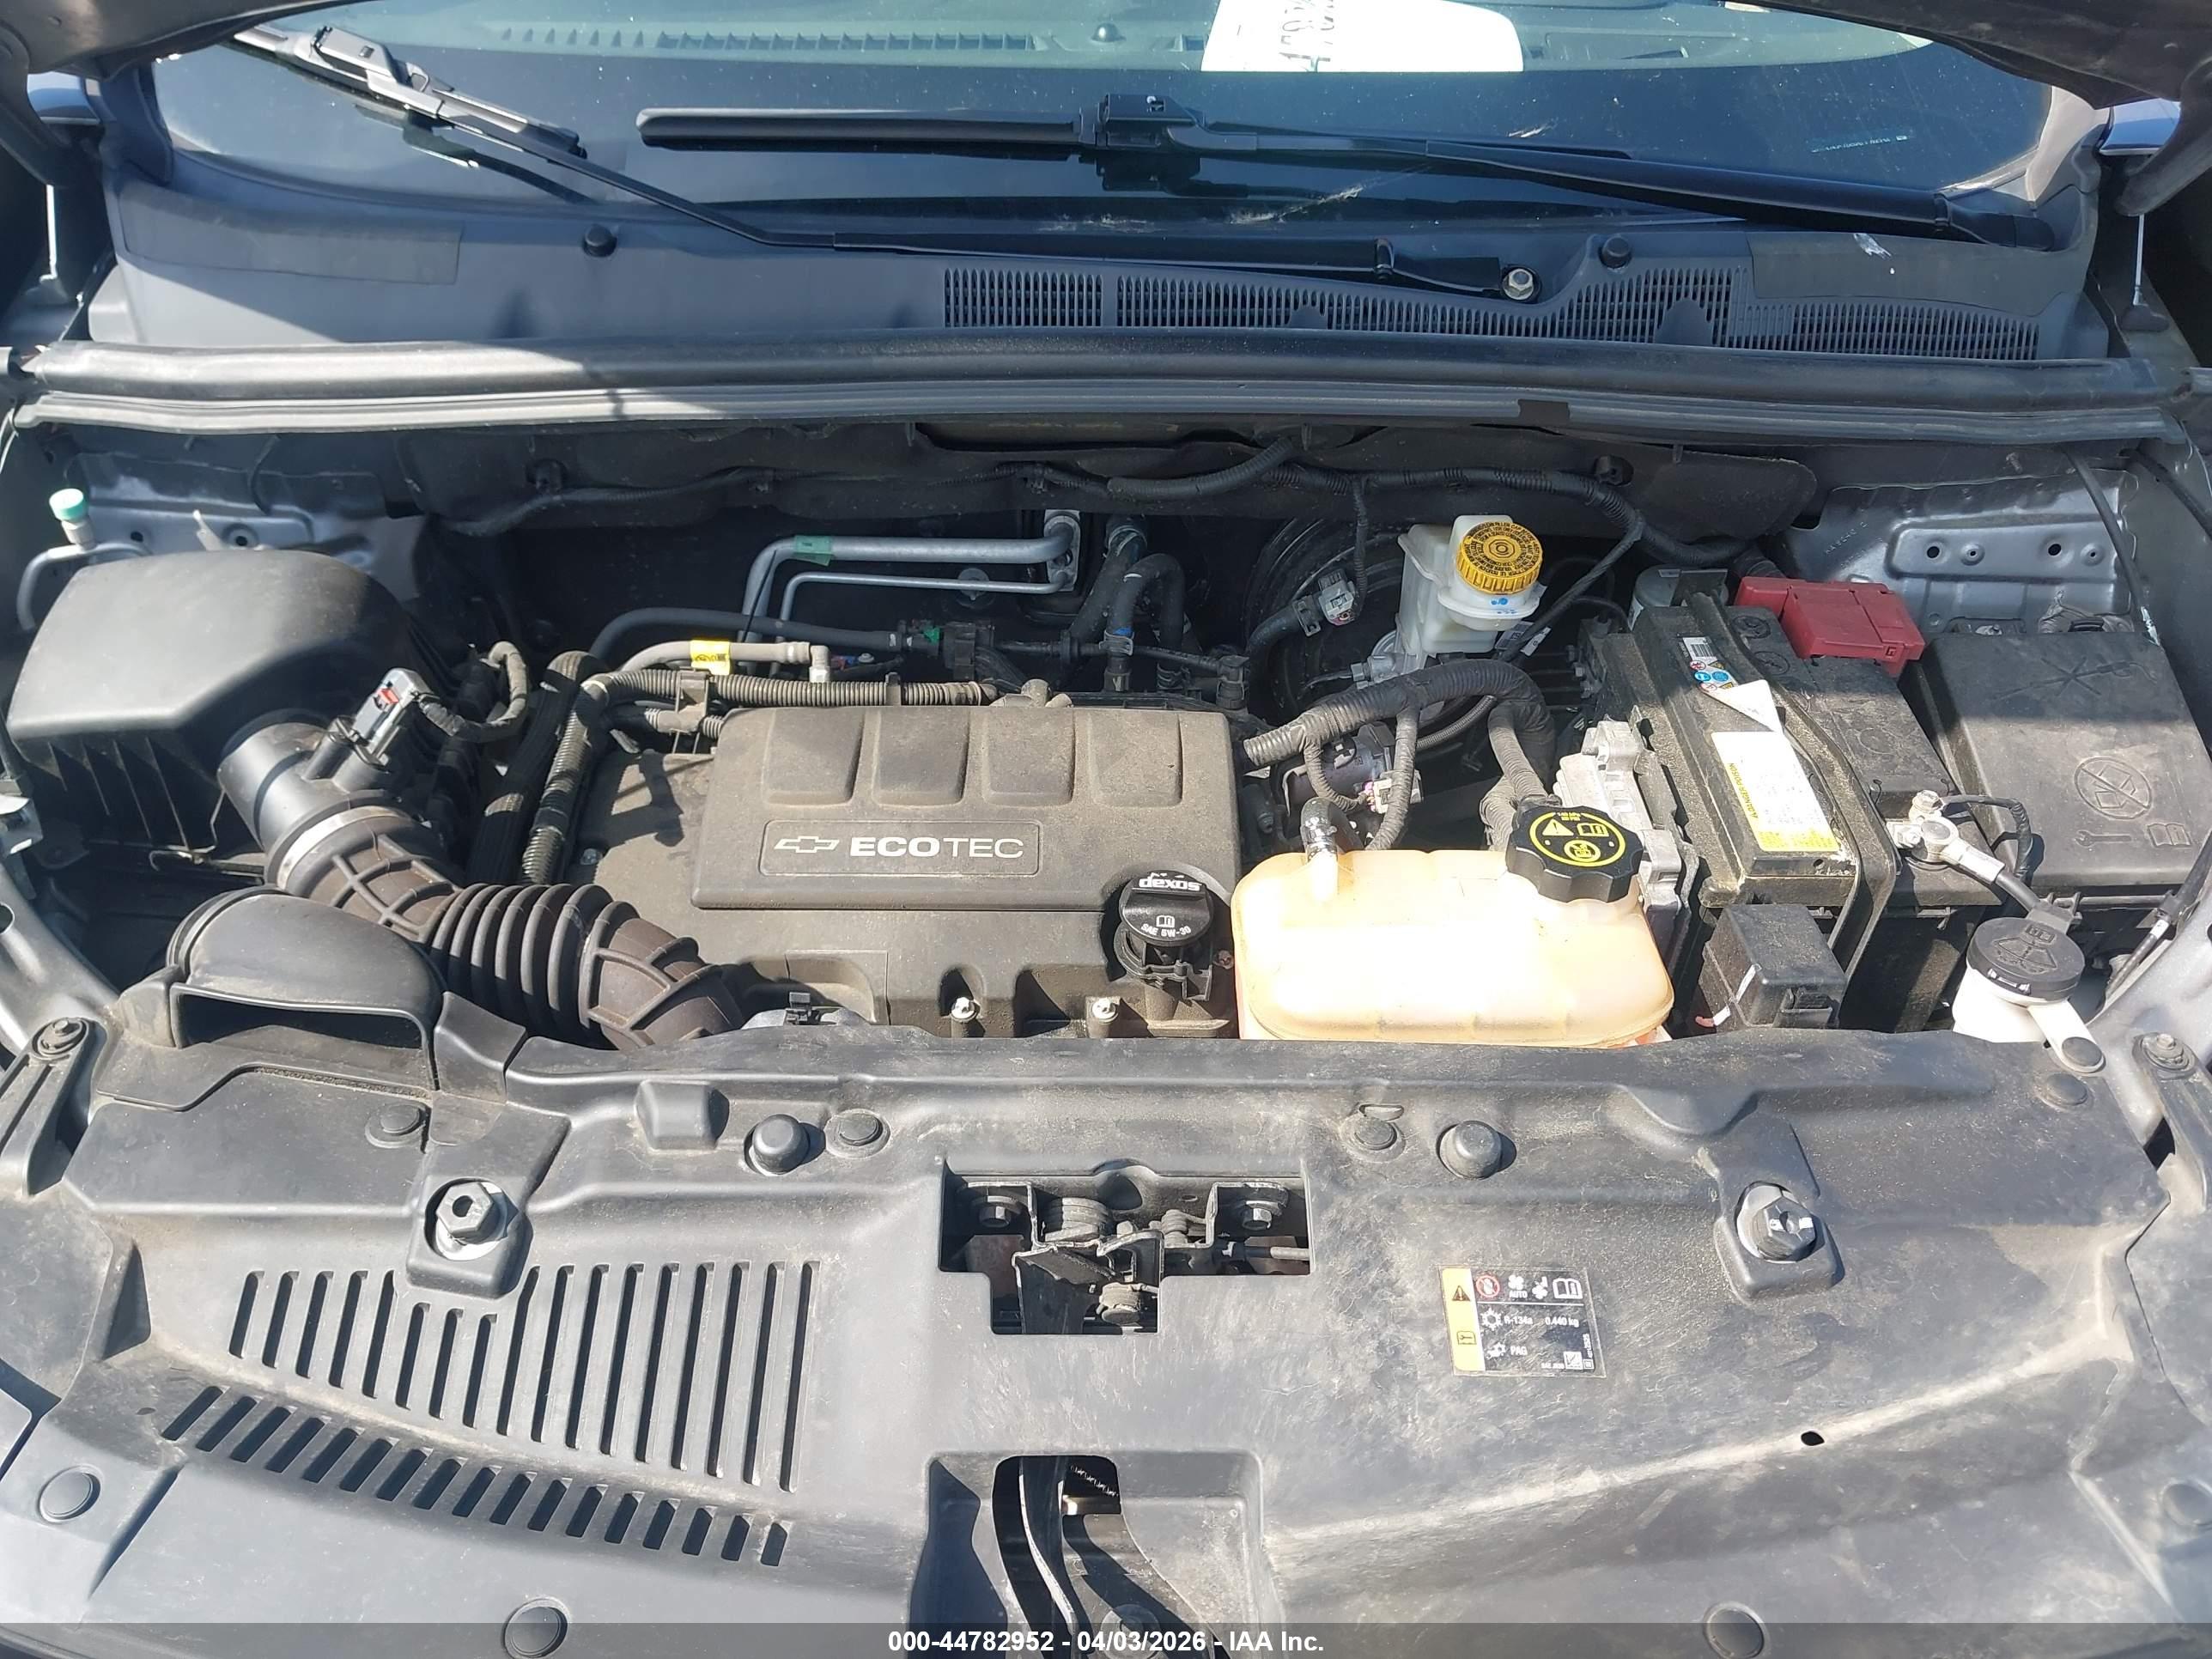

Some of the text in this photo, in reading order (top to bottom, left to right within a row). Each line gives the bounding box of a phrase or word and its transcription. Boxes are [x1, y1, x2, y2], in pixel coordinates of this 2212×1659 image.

[850, 836, 1024, 859] ECOTEC
[1139, 875, 1202, 891] dexos
[1140, 923, 1192, 938] SAE 5W-30
[1569, 1317, 1579, 1328] kg
